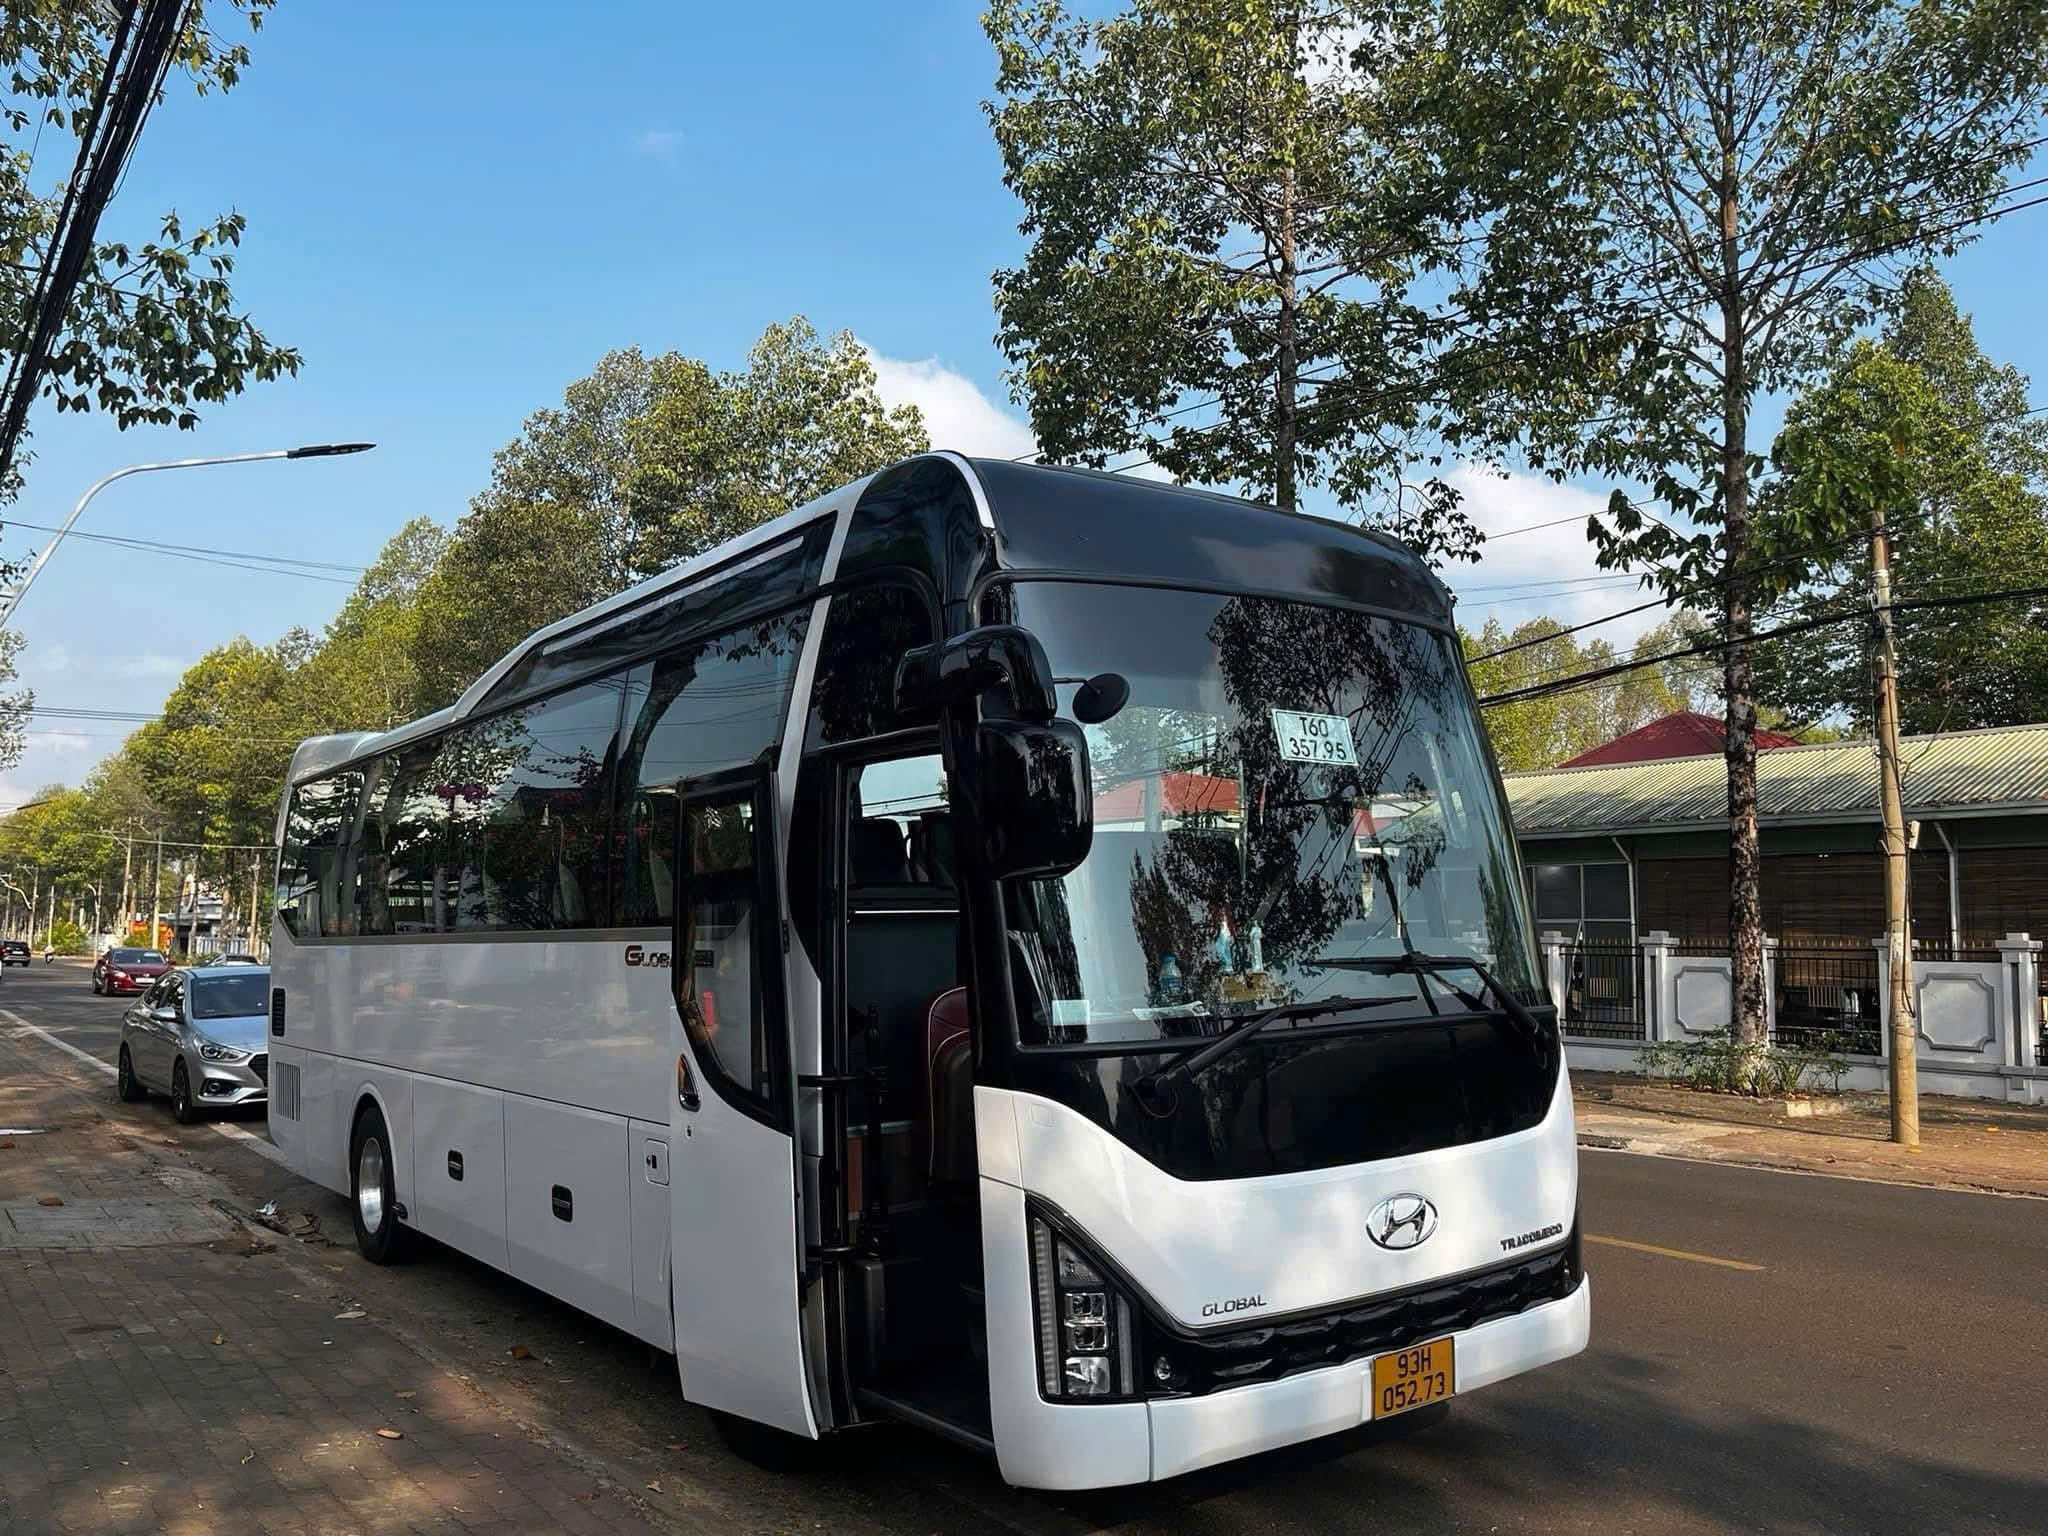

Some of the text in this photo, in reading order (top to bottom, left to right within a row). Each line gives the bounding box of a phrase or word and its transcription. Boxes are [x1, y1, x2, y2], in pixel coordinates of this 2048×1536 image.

[1299, 716, 1328, 738] T60
[1289, 737, 1347, 760] 357.95
[1202, 1294, 1268, 1317] GLOBAL
[1397, 1344, 1432, 1379] 93H
[1383, 1371, 1446, 1412] 052.73
